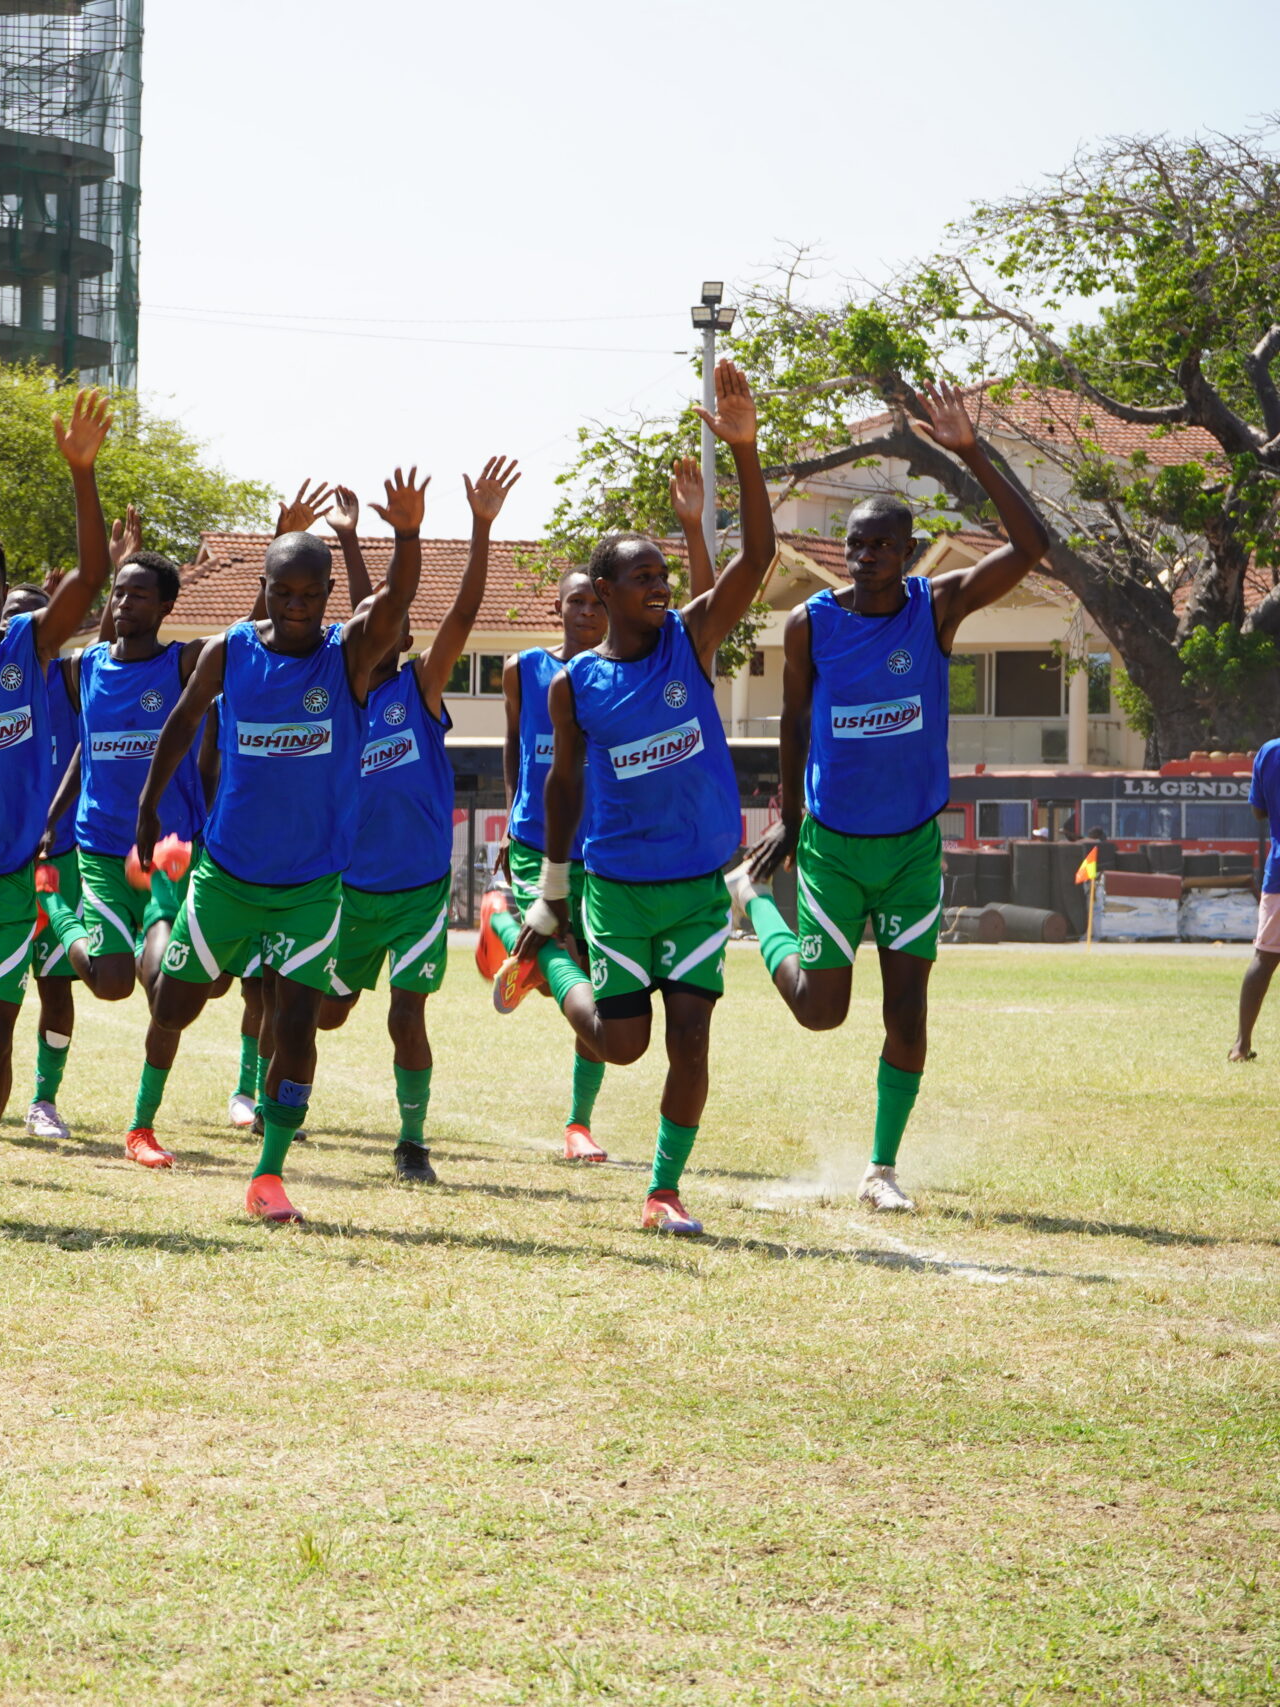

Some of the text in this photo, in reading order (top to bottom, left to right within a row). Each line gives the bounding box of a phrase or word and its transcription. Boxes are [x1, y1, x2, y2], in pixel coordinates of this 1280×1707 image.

[833, 706, 920, 728] USHINDI
[239, 731, 331, 748] USHINDI
[614, 730, 700, 769] USHINDI
[1123, 780, 1252, 796] LEGENDS
[878, 913, 902, 936] 15
[273, 932, 296, 960] 27
[661, 940, 676, 966] 2
